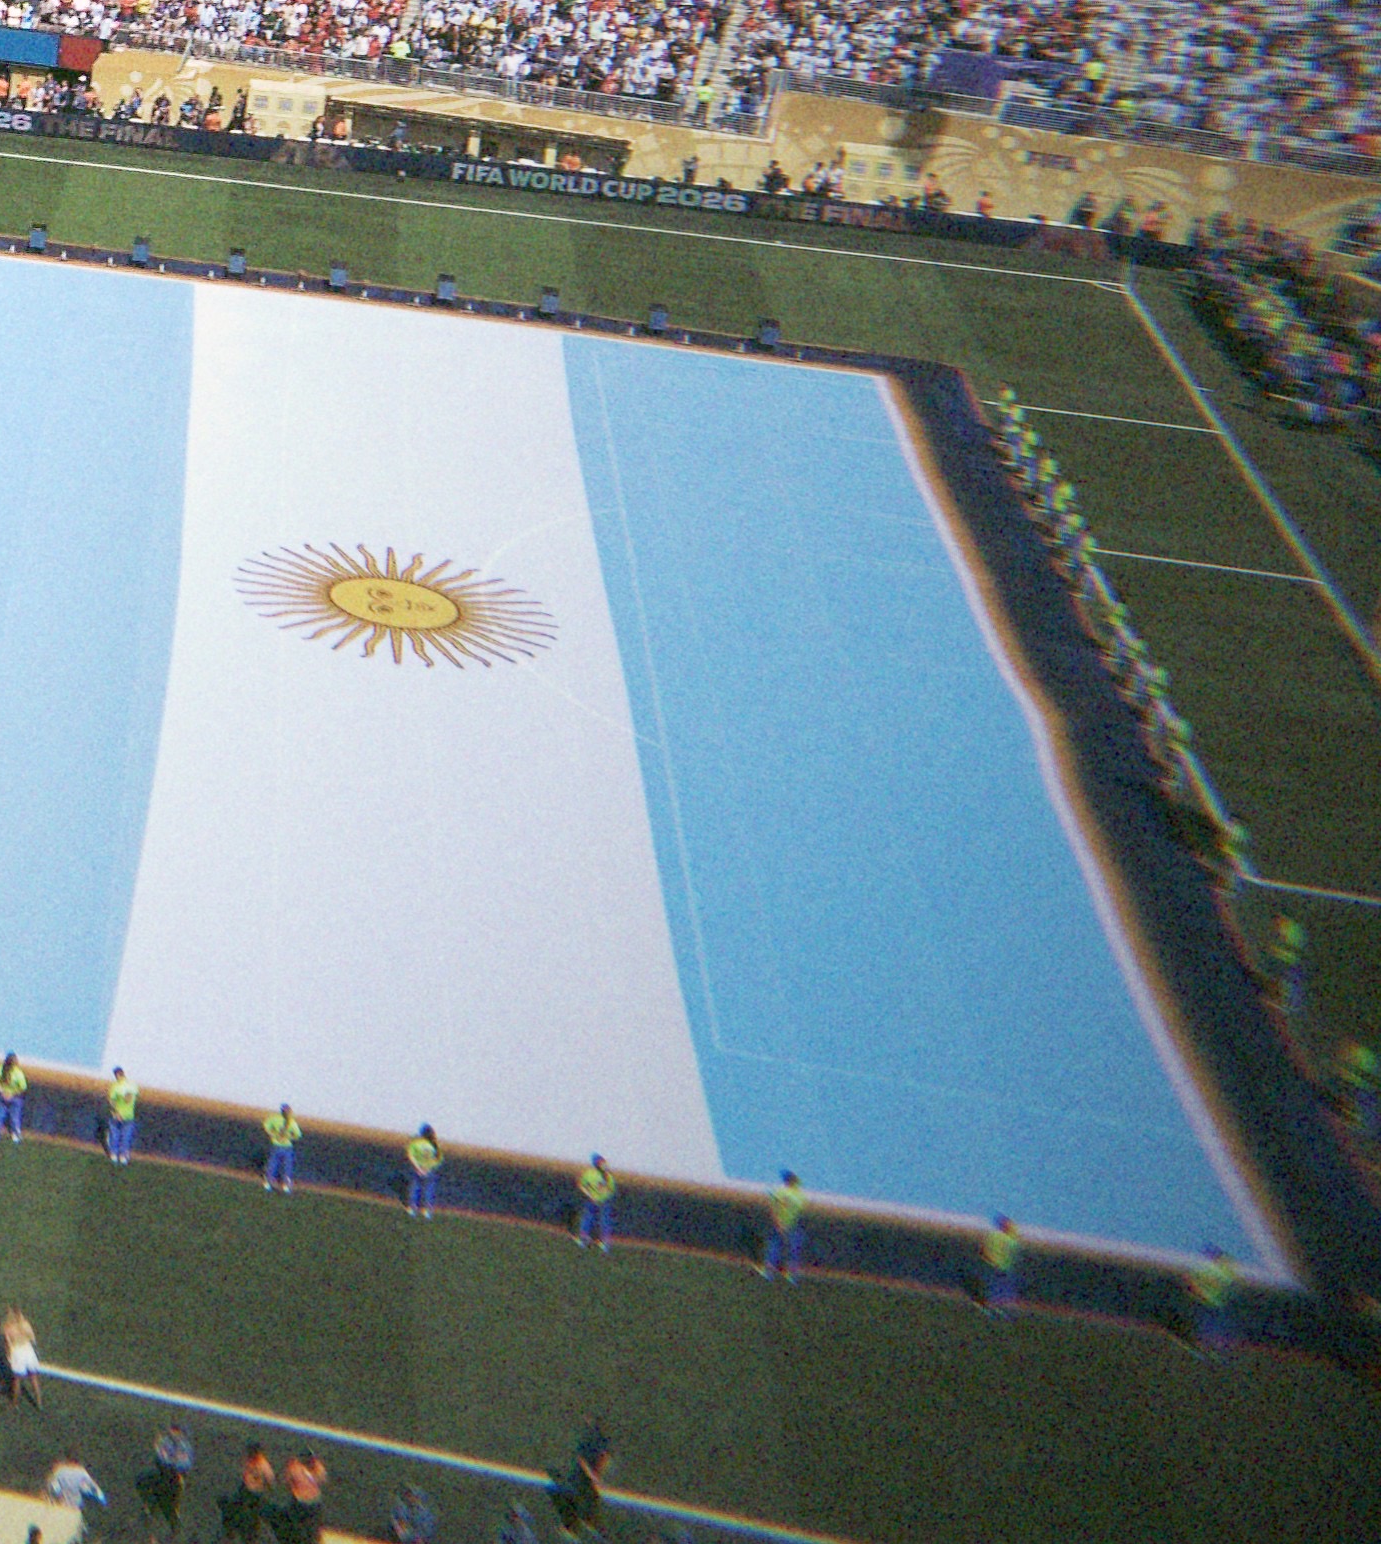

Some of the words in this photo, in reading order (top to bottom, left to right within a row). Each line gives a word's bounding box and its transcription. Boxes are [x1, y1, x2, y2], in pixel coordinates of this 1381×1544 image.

[450, 160, 506, 186] FIFA
[507, 167, 599, 196] WORLD
[600, 178, 654, 203] CUP
[656, 186, 749, 214] 2026
